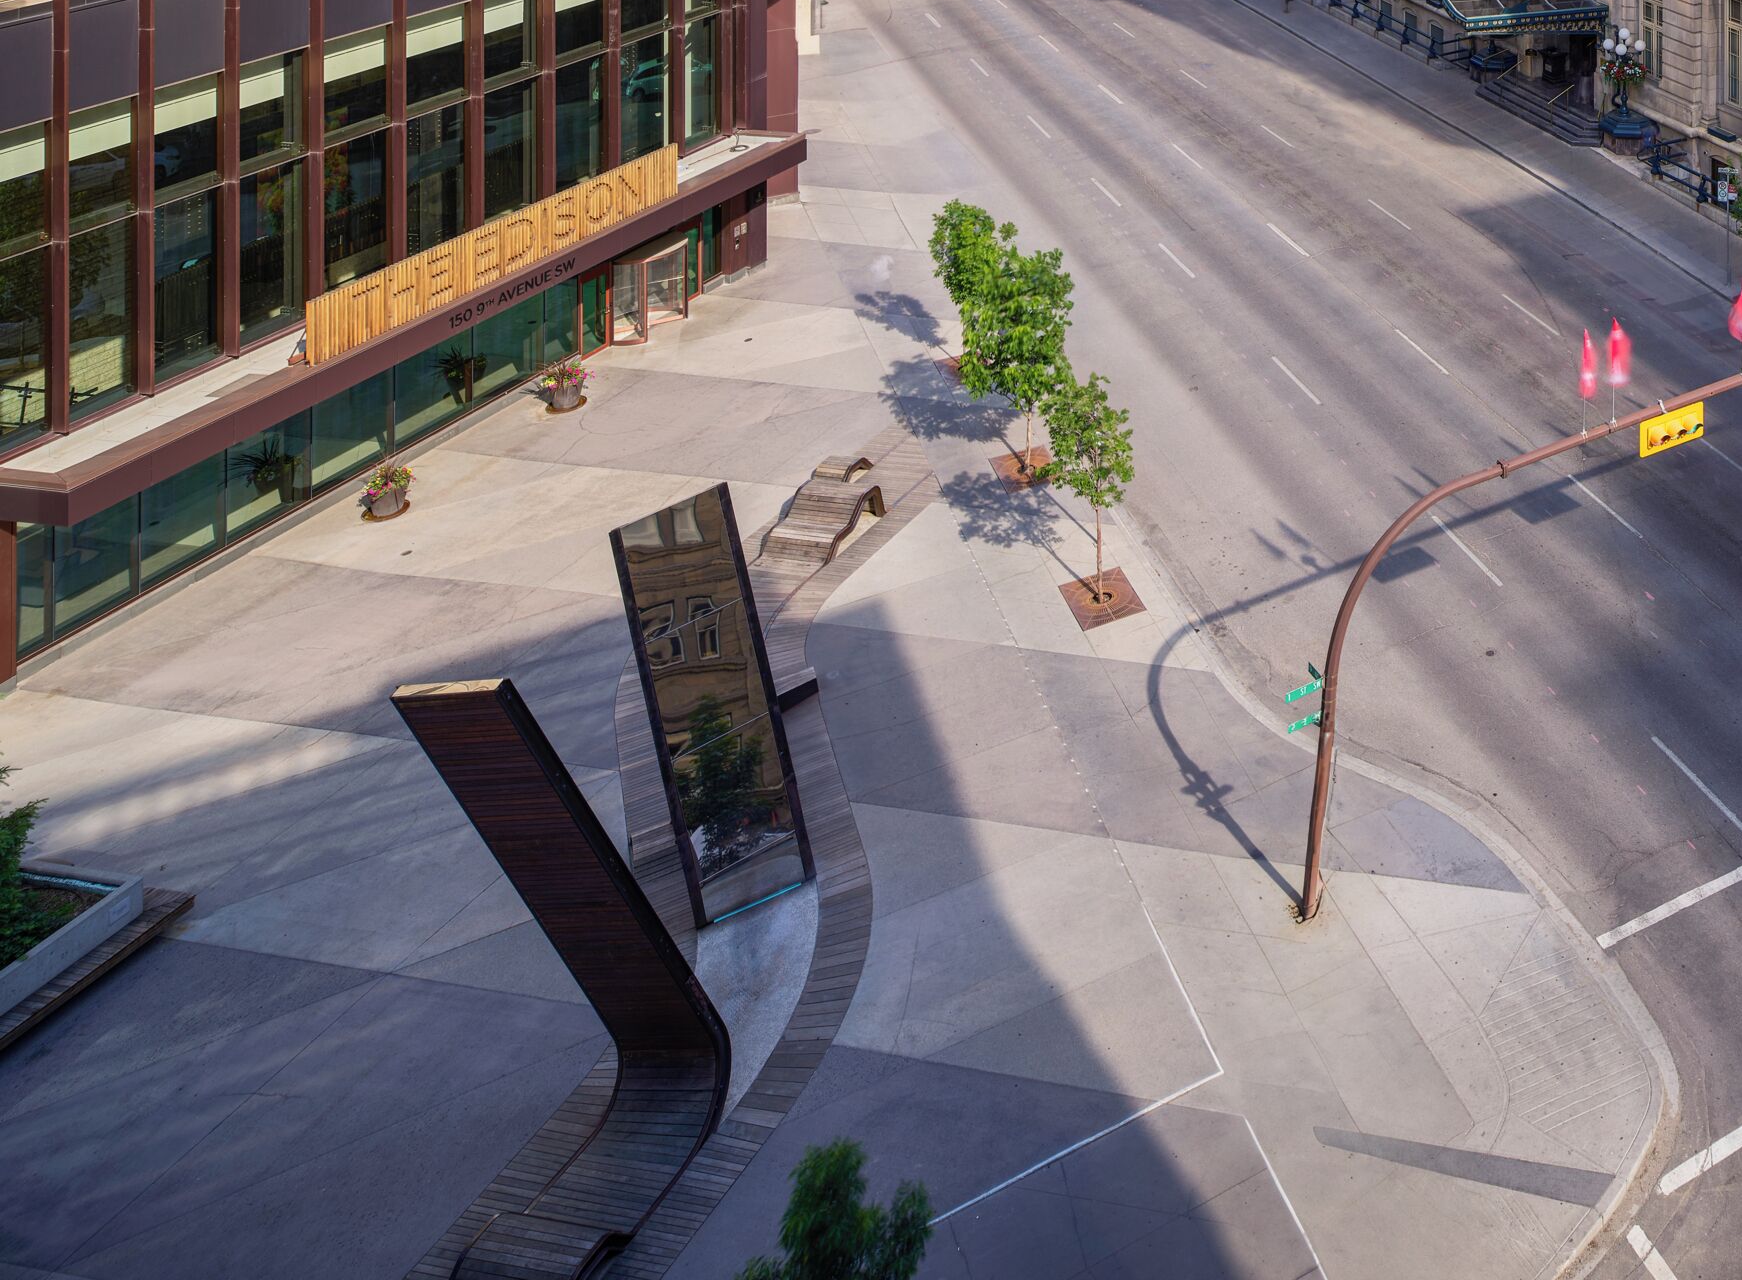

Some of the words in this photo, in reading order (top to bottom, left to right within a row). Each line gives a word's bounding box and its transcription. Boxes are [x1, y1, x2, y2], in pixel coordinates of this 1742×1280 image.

[351, 251, 453, 339] THE
[475, 166, 644, 281] EDISON
[448, 308, 473, 329] 150
[476, 298, 495, 316] 9TH
[497, 270, 553, 306] AVENUE
[554, 257, 576, 278] SW
[1300, 686, 1307, 696] ST
